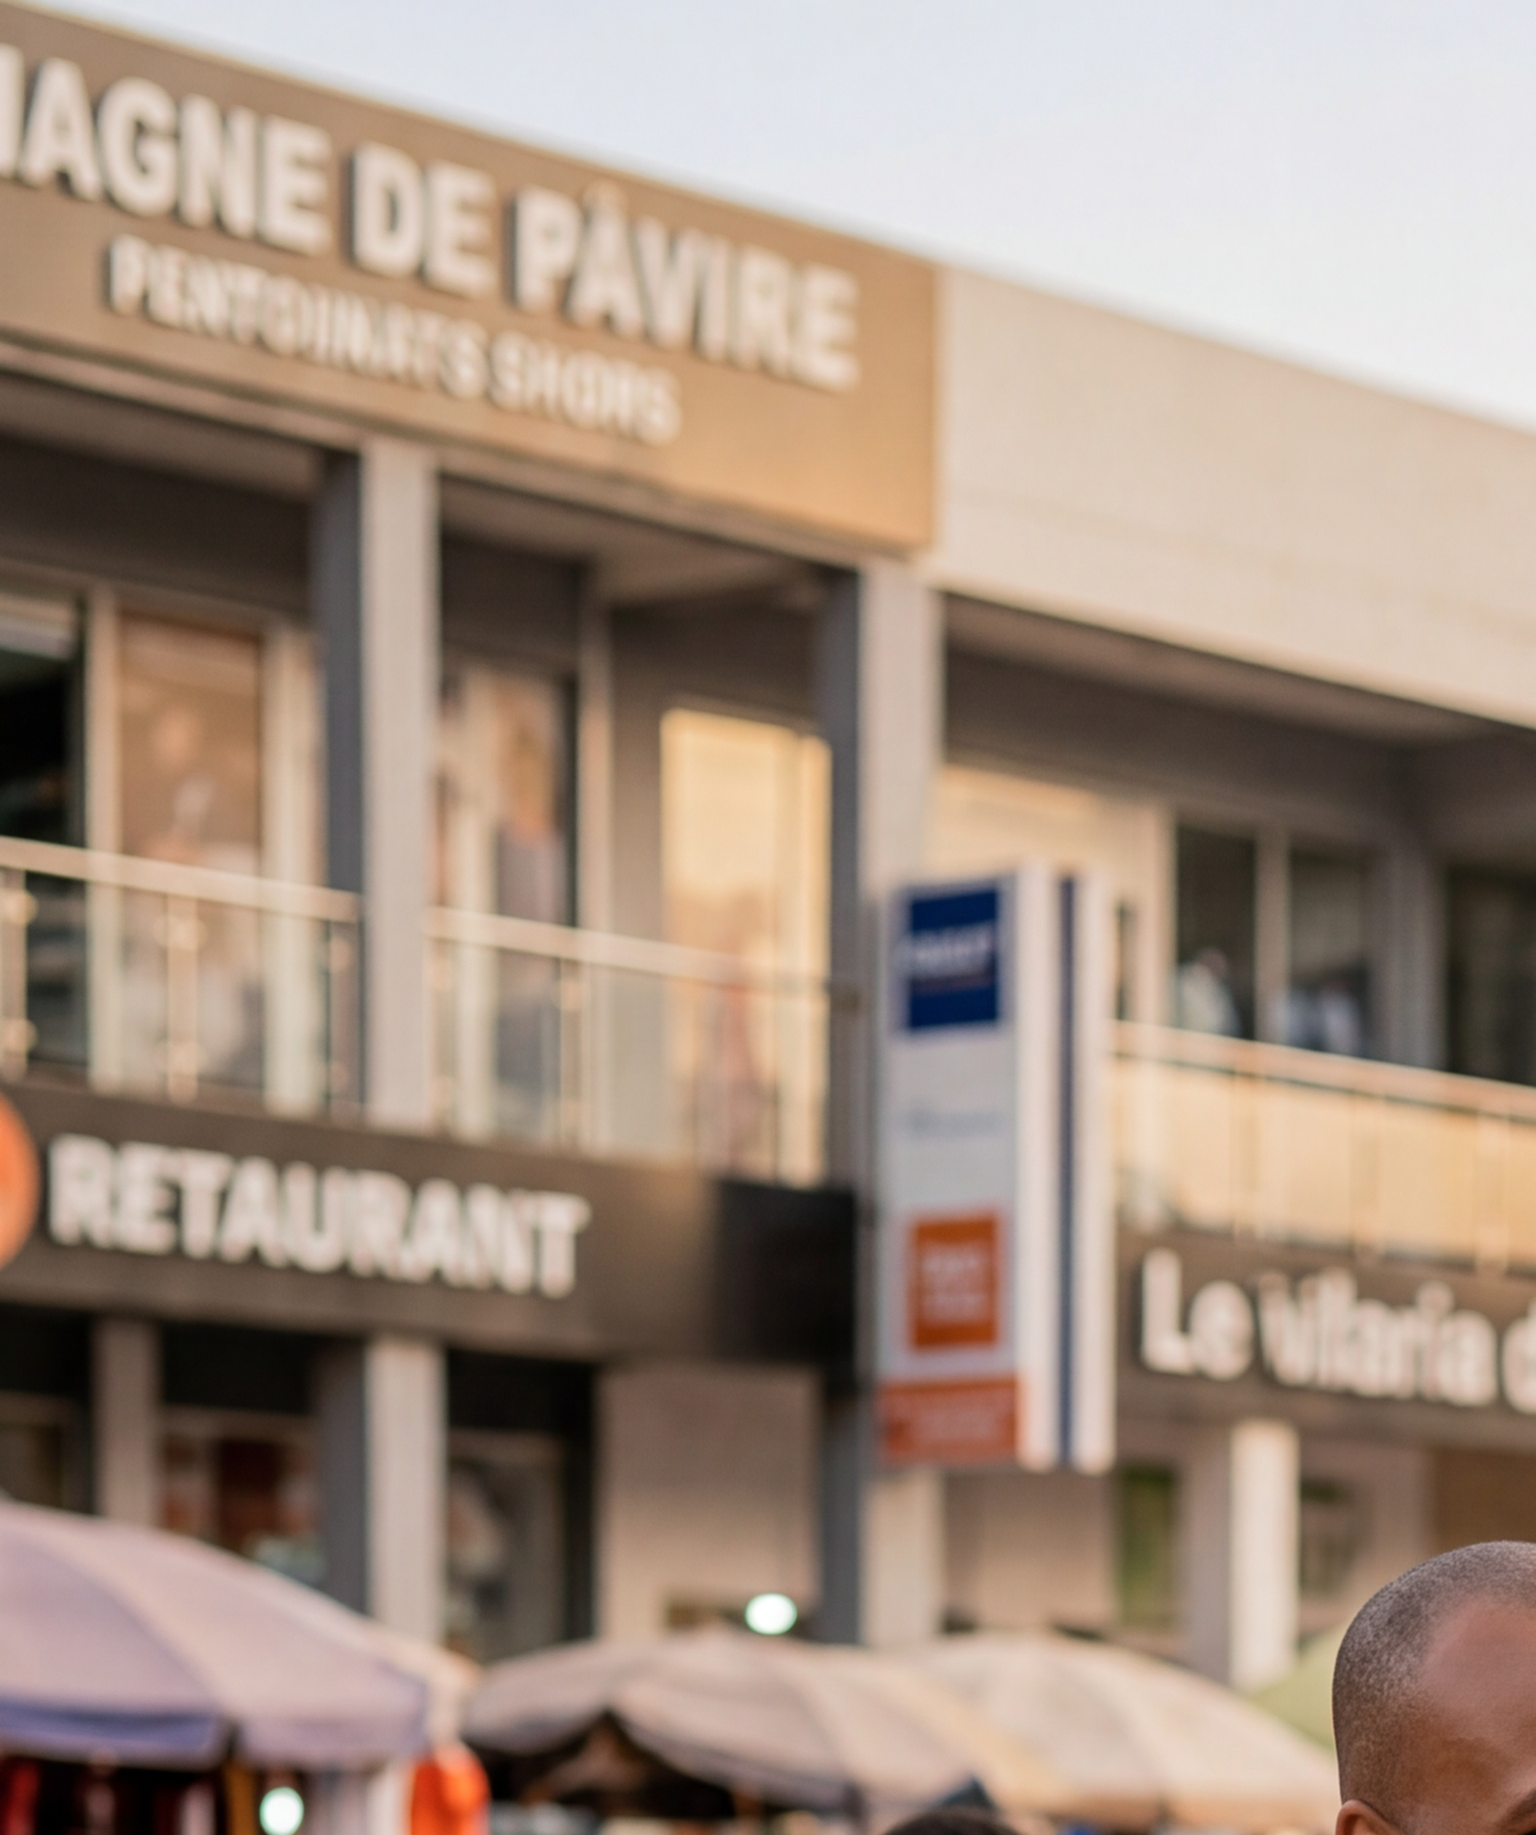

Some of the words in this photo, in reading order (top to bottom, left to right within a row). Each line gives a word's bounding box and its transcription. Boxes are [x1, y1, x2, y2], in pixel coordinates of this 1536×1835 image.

[352, 140, 494, 298] DE
[48, 1133, 590, 1298] RETAURANT
[1142, 1248, 1252, 1382] Le
